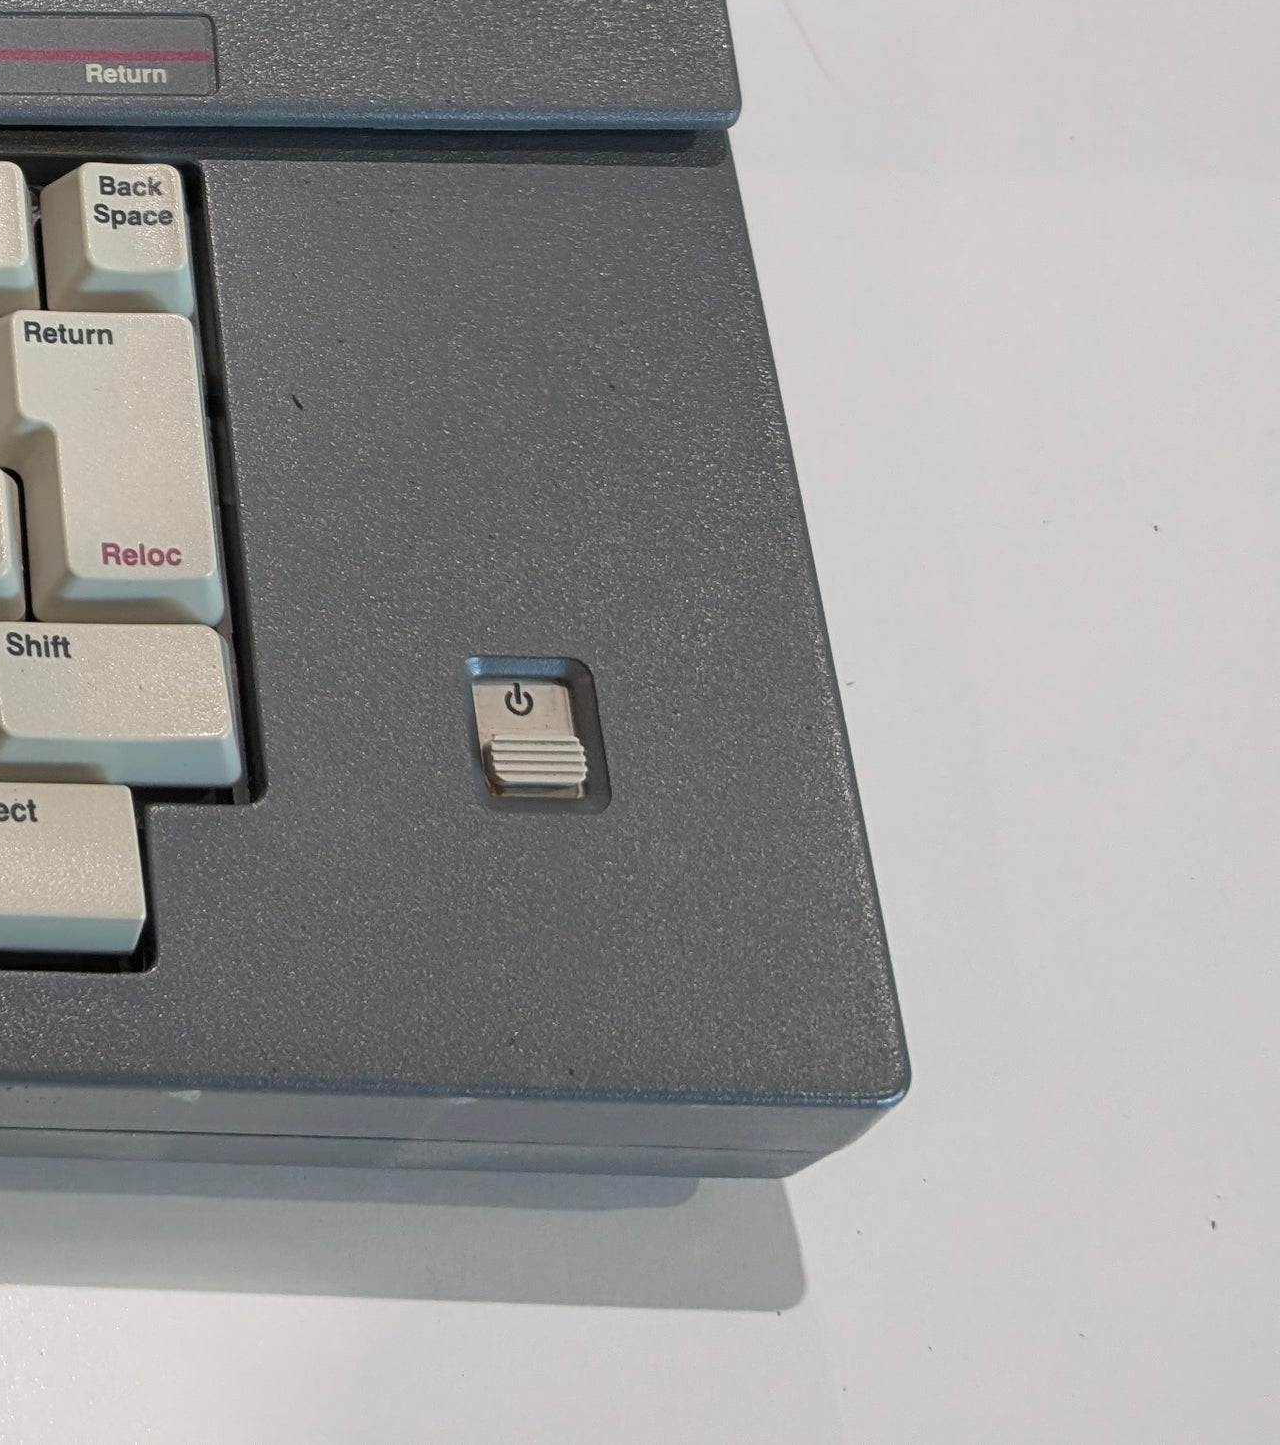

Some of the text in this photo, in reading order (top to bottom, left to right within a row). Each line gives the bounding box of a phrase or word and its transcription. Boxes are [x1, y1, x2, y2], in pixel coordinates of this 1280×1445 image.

[86, 64, 166, 83] Return
[99, 176, 162, 196] Back
[94, 204, 173, 229] Space
[24, 321, 113, 344] Return
[101, 542, 182, 566] Reloc
[7, 632, 71, 658] Shift
